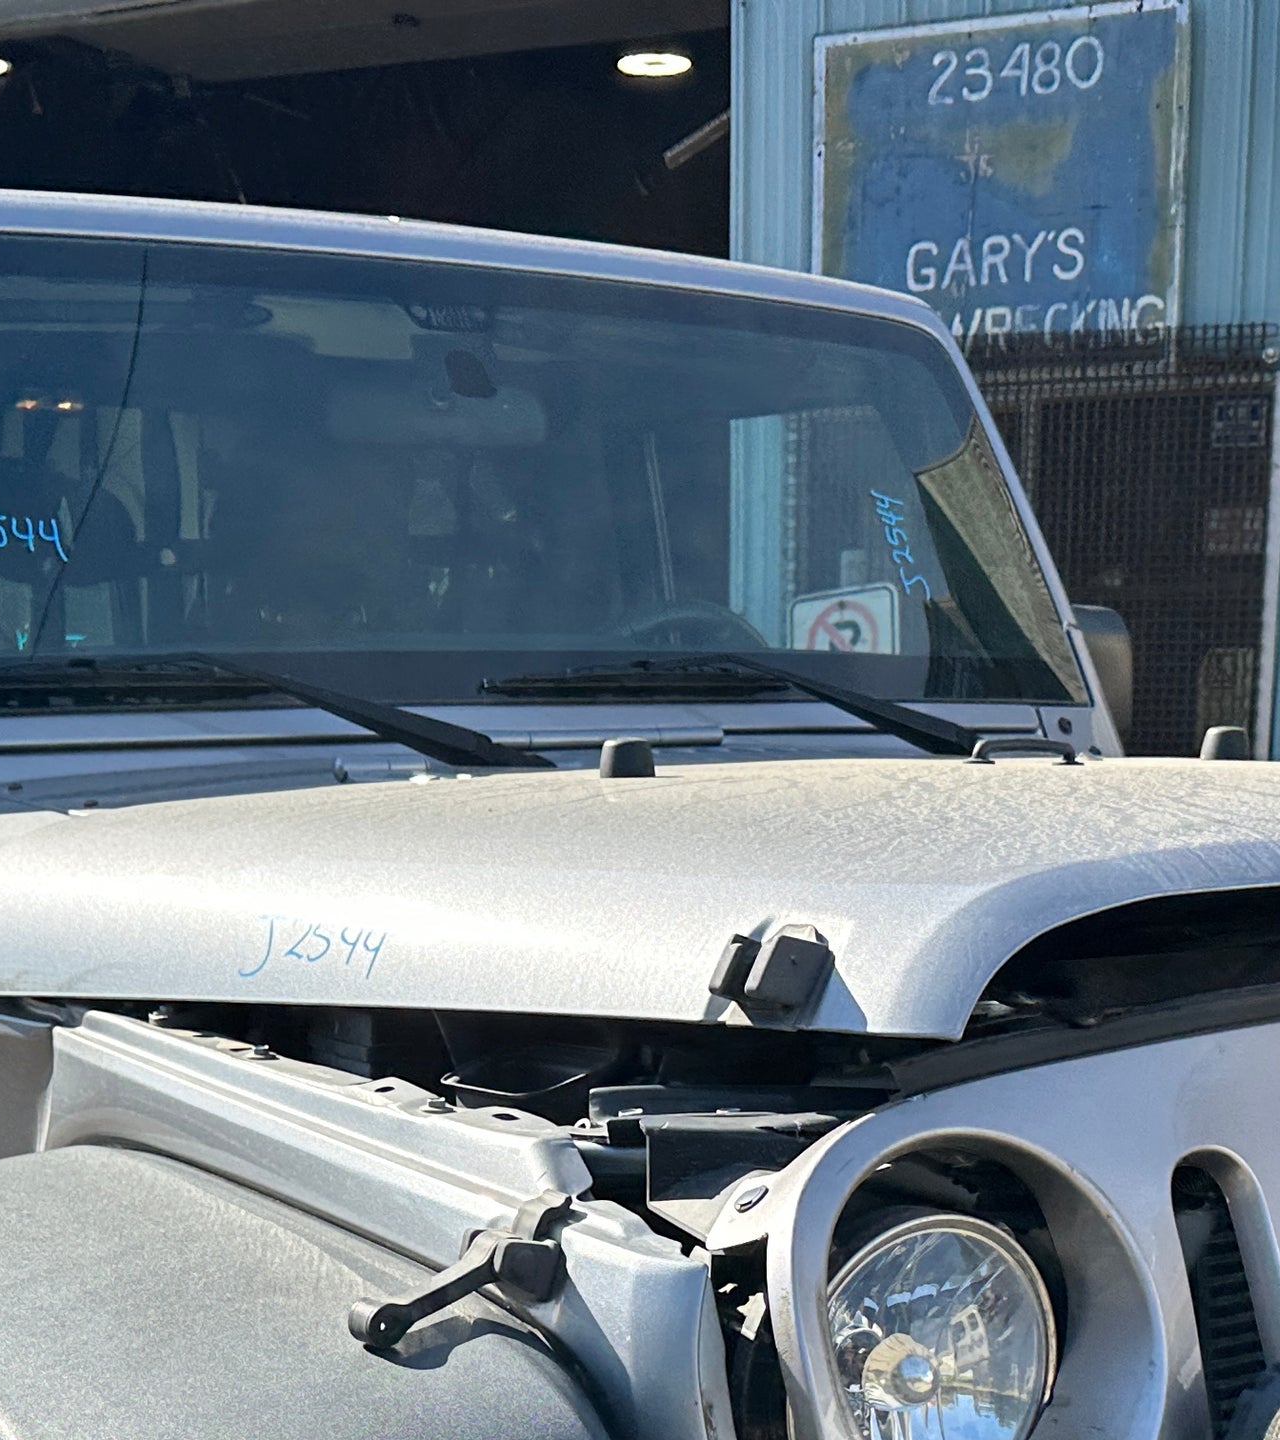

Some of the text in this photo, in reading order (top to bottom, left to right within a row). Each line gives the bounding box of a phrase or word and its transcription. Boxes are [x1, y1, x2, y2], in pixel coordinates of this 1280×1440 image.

[927, 36, 1105, 105] 23480
[905, 227, 1086, 292] GARY'S
[870, 488, 931, 601] J2544
[238, 914, 387, 980] J2544
